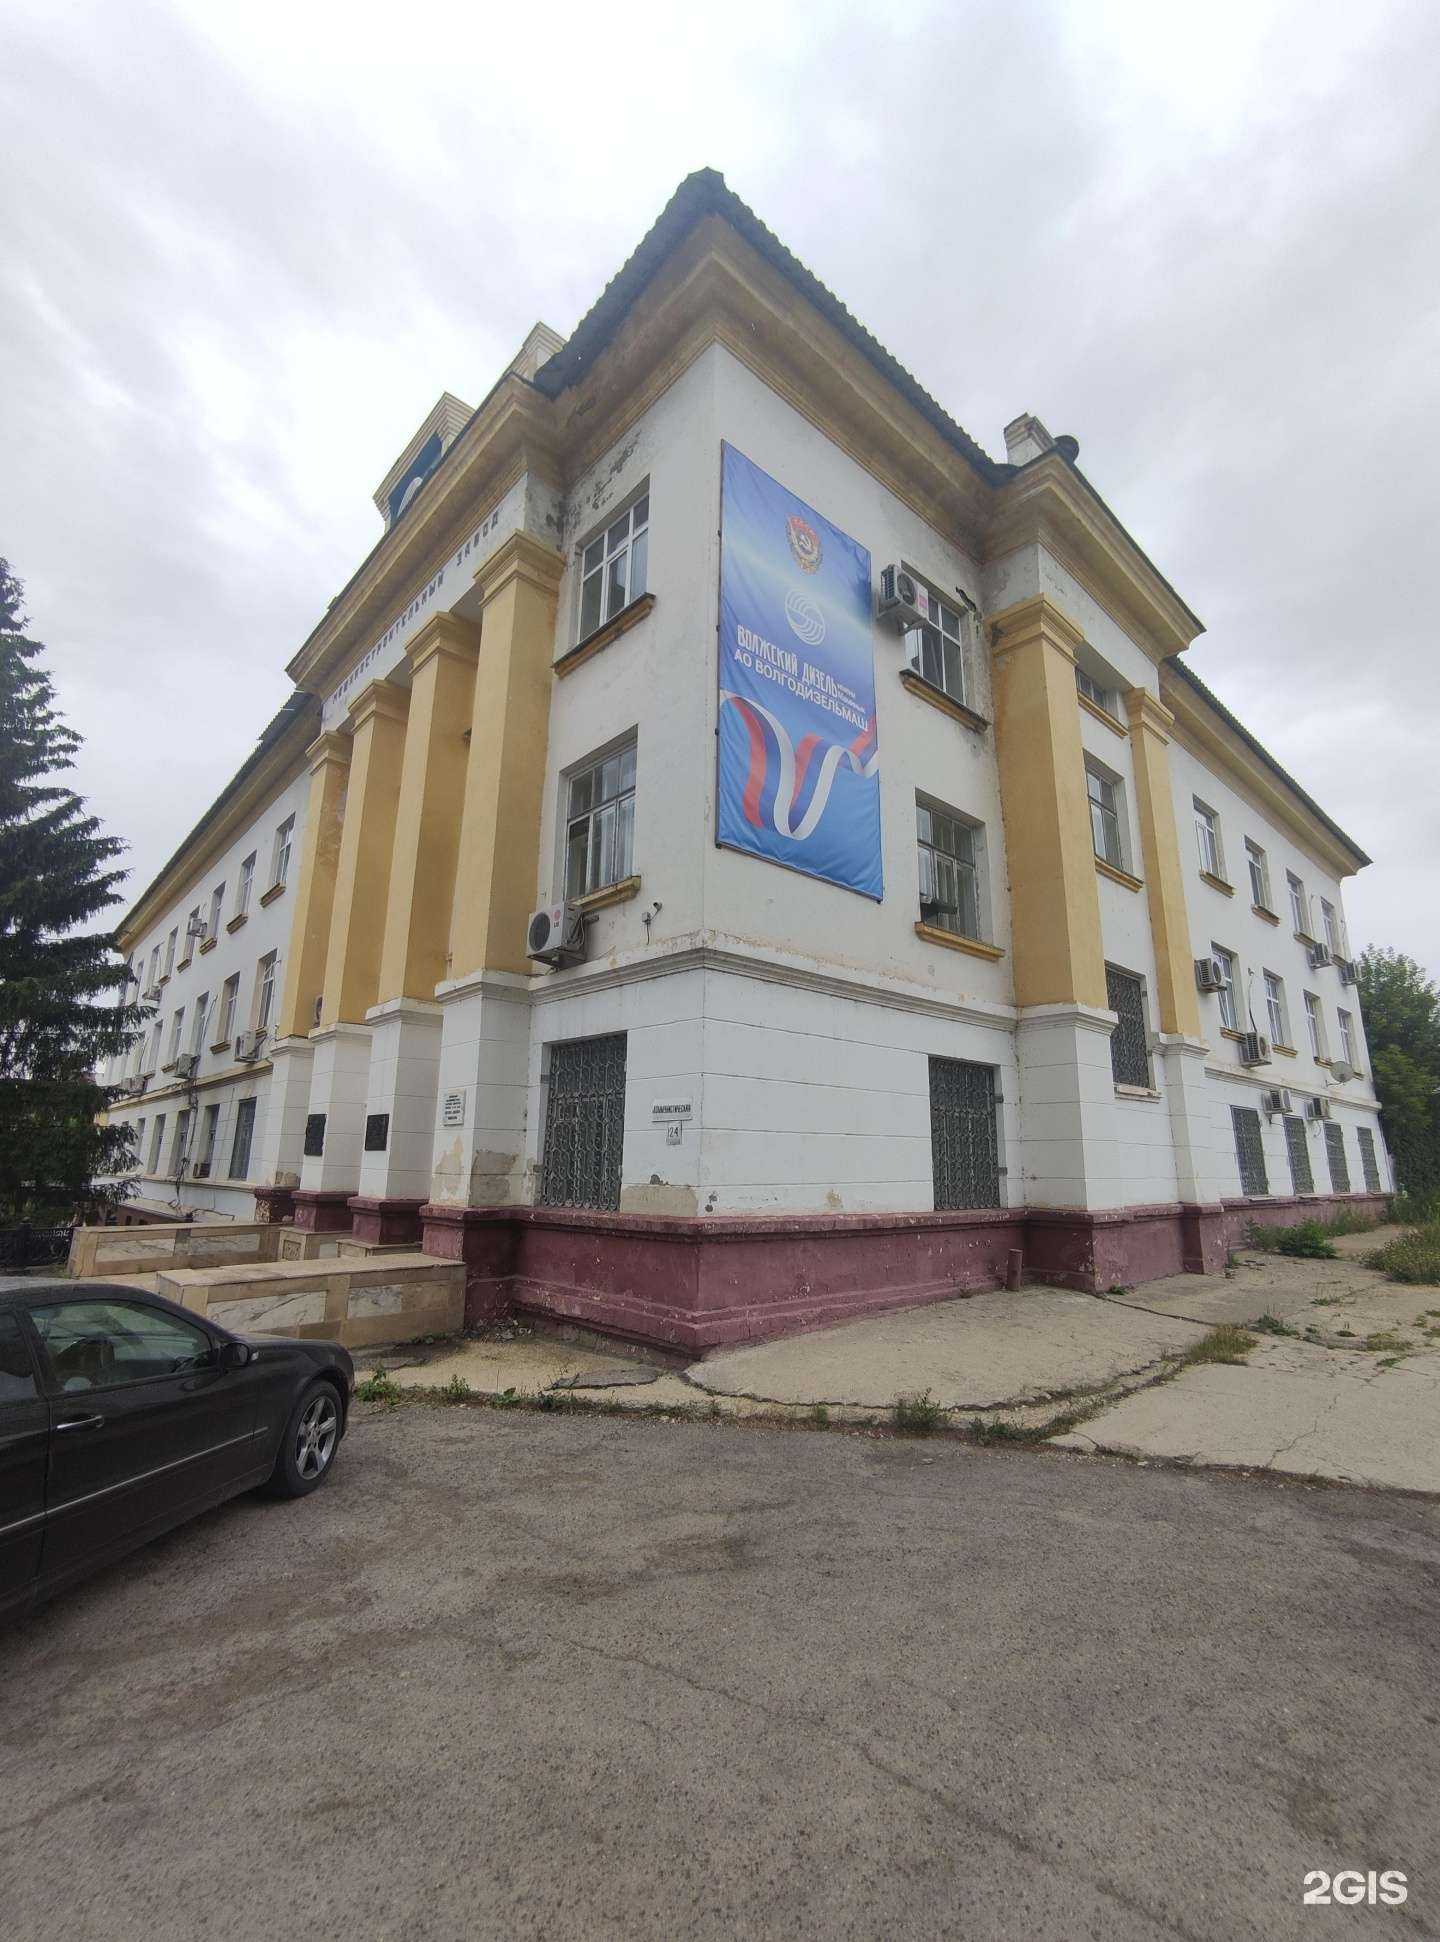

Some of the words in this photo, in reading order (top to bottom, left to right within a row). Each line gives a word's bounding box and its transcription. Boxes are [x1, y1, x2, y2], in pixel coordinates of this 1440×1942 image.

[456, 510, 500, 567] ЗАВОД
[734, 648, 753, 668] АО
[755, 659, 869, 732] ВОЛГОДИЗЕЛЬМАШ
[736, 624, 799, 677] ВОЛЖСКИЙ
[802, 661, 839, 698] ДИЗЕЛЬ
